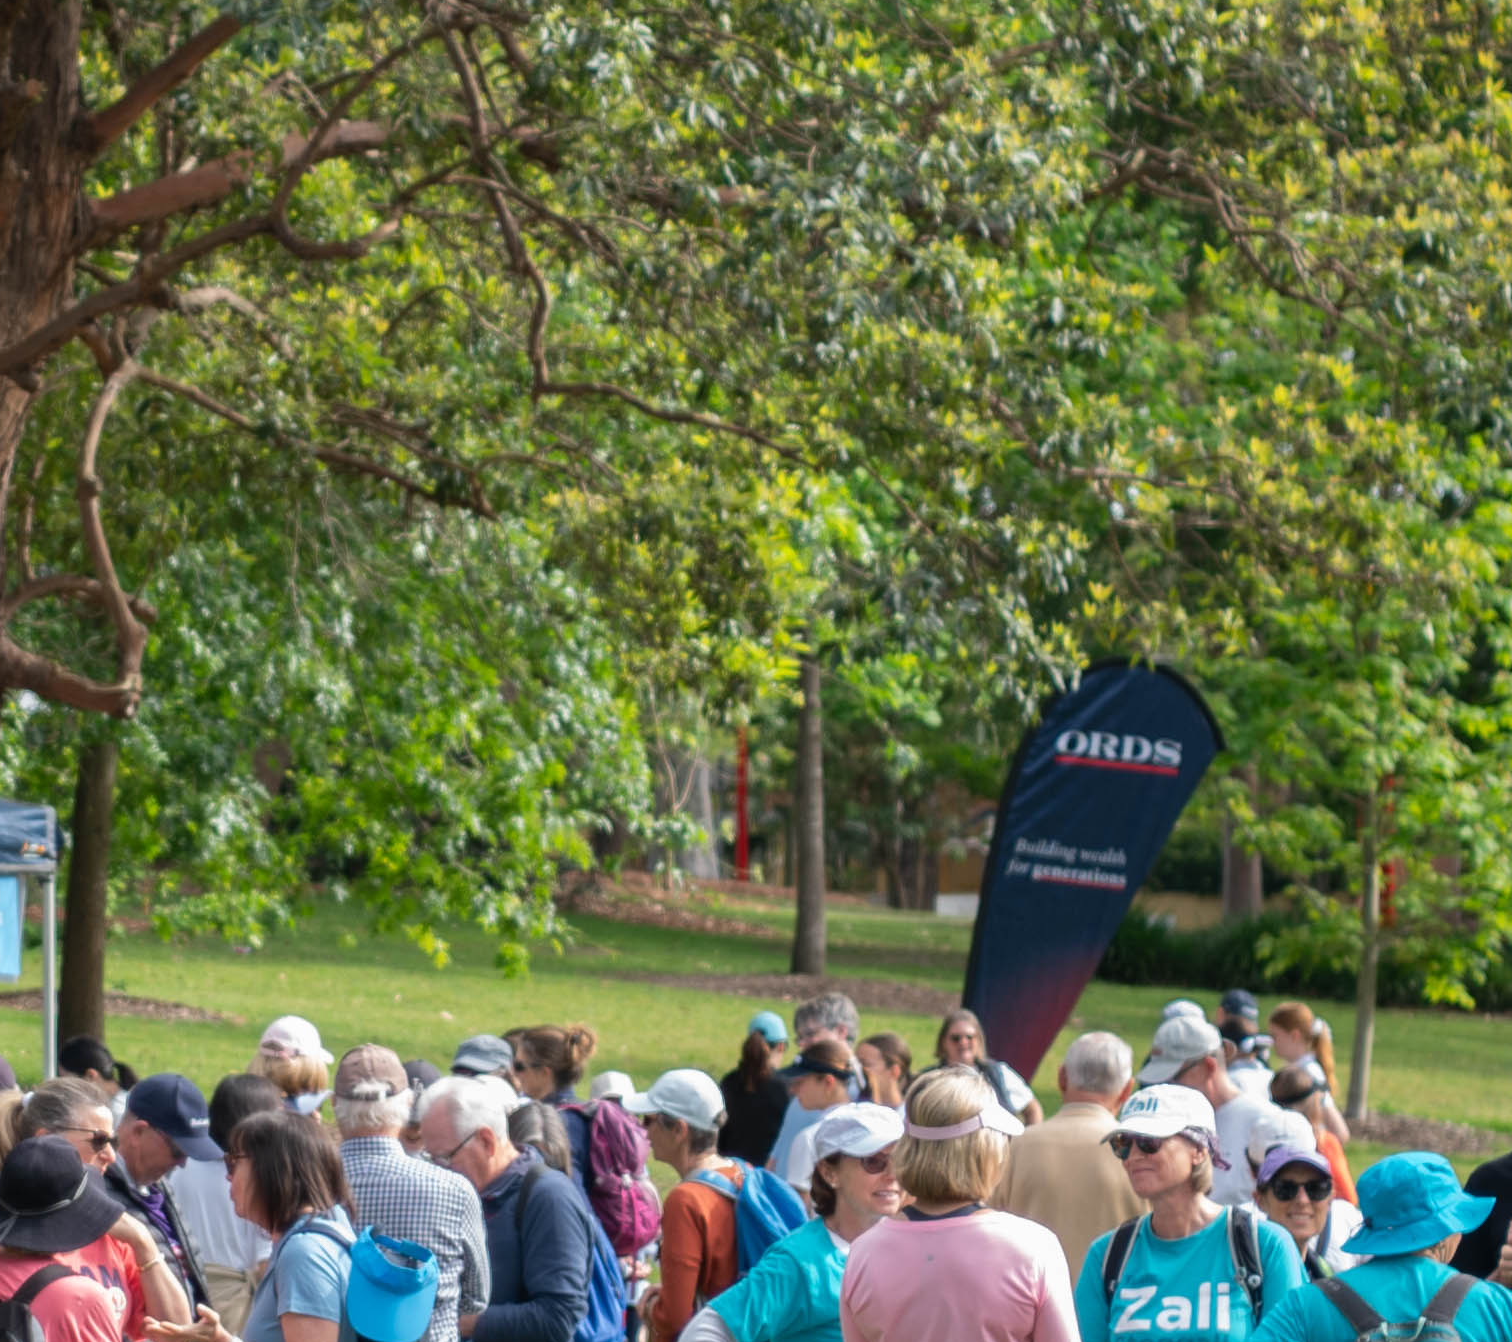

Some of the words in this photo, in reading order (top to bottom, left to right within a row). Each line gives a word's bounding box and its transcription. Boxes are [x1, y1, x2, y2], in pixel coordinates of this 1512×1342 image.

[1055, 729, 1182, 766] ORDS
[1015, 837, 1077, 863] Building
[1080, 846, 1127, 866] wealth
[1005, 856, 1031, 877] for
[1031, 862, 1127, 886] generations
[1114, 1281, 1231, 1334] Zali
